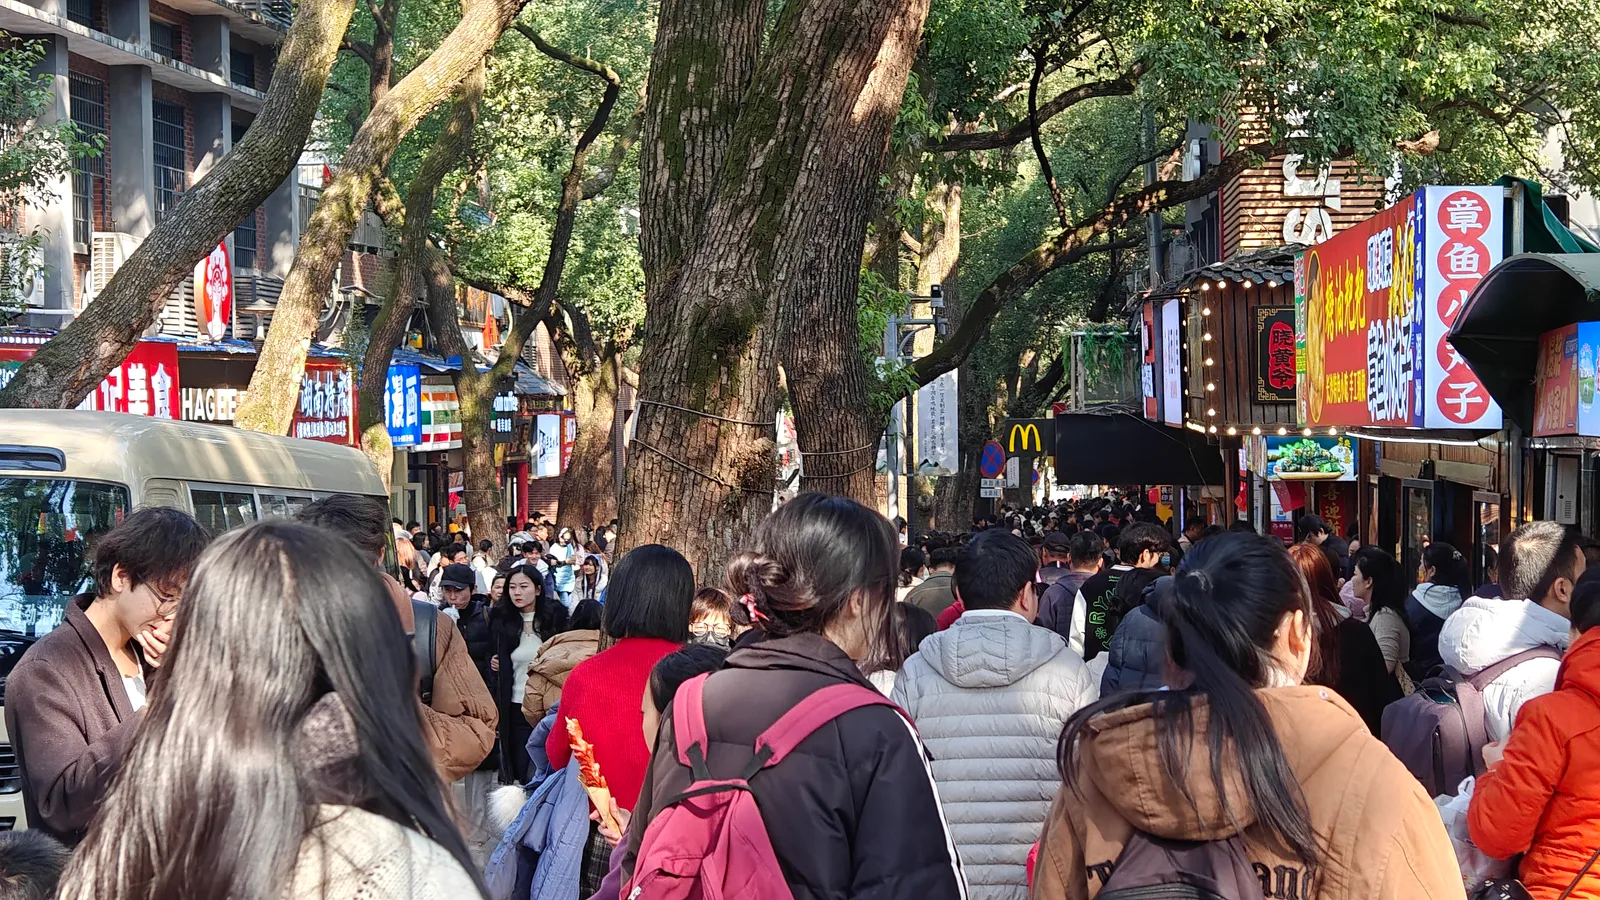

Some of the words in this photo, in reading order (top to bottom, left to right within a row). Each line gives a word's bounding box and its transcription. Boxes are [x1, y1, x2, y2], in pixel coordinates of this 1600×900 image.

[1326, 254, 1366, 343] 糖油粑粑
[75, 362, 172, 419] 记美食
[179, 387, 238, 421] HAGEE
[1367, 318, 1415, 423] 章鱼小丸子
